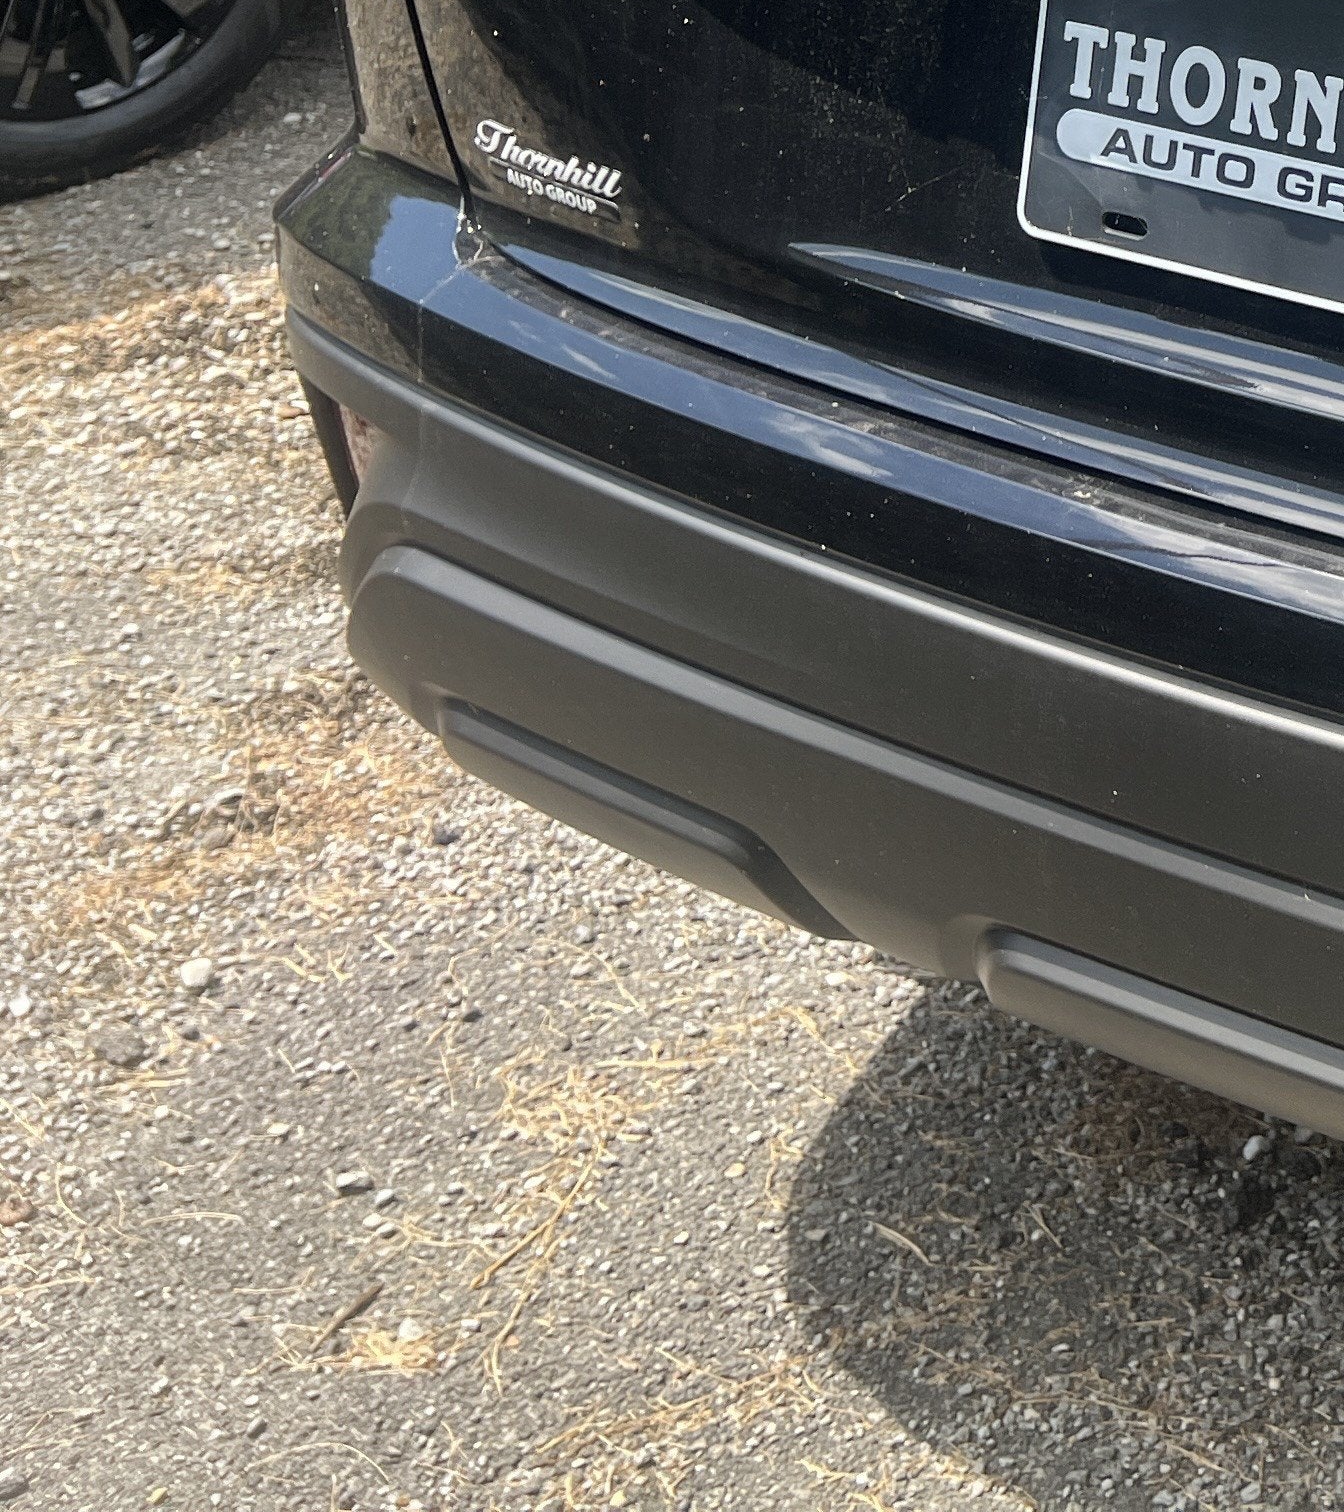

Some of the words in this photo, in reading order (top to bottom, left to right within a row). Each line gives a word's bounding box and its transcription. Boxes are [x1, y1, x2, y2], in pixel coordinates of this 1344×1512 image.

[474, 119, 622, 198] Thornhill
[1100, 128, 1256, 189] AUTO
[507, 168, 544, 196] AUTO
[545, 184, 597, 214] GROUP
